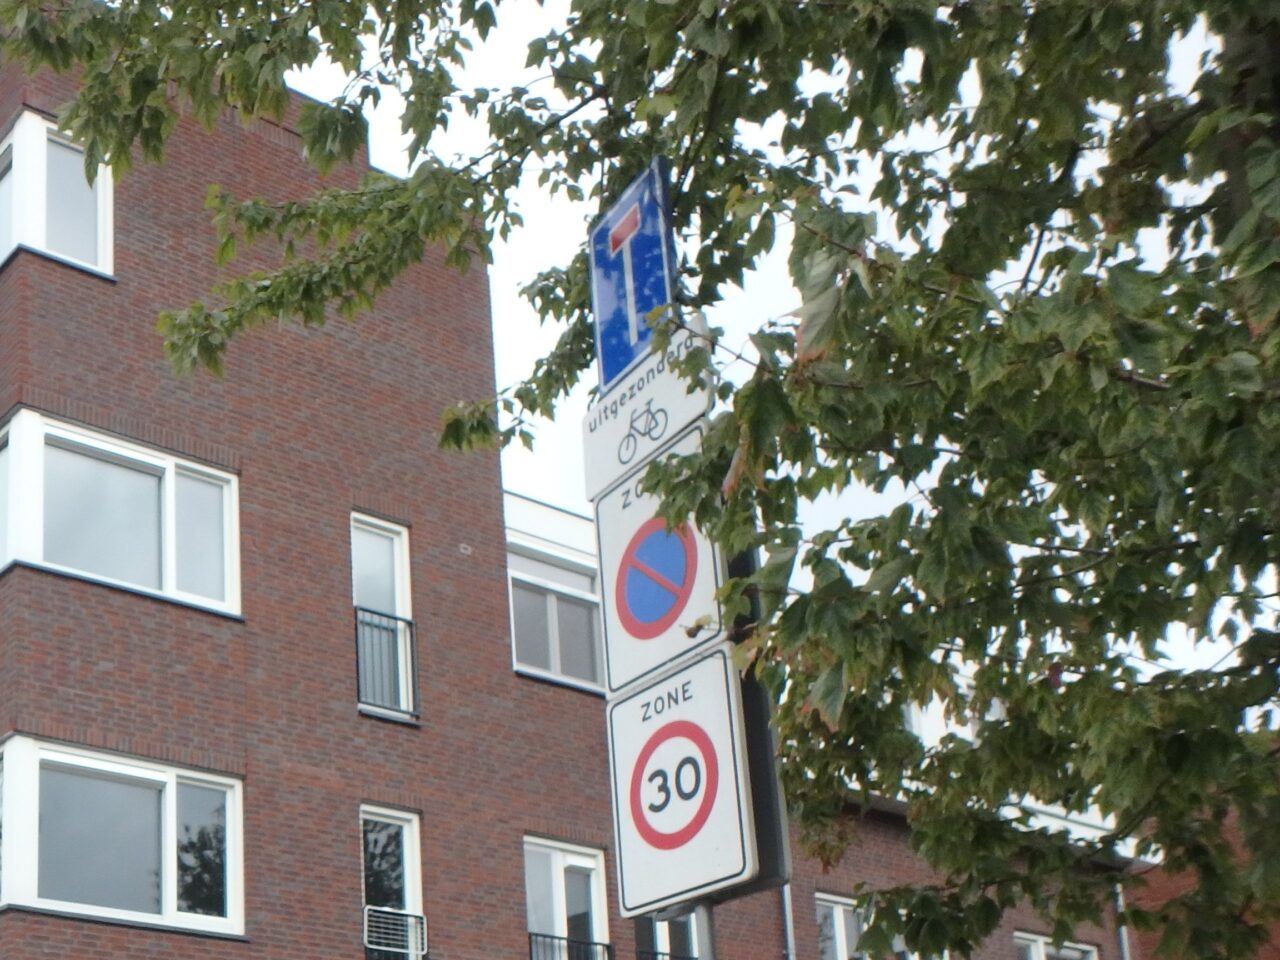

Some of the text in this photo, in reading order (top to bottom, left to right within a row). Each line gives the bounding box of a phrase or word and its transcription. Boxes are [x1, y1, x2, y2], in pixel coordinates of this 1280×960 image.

[589, 330, 693, 432] uitgezonderd
[641, 680, 693, 722] ZONE
[648, 756, 701, 813] 30
